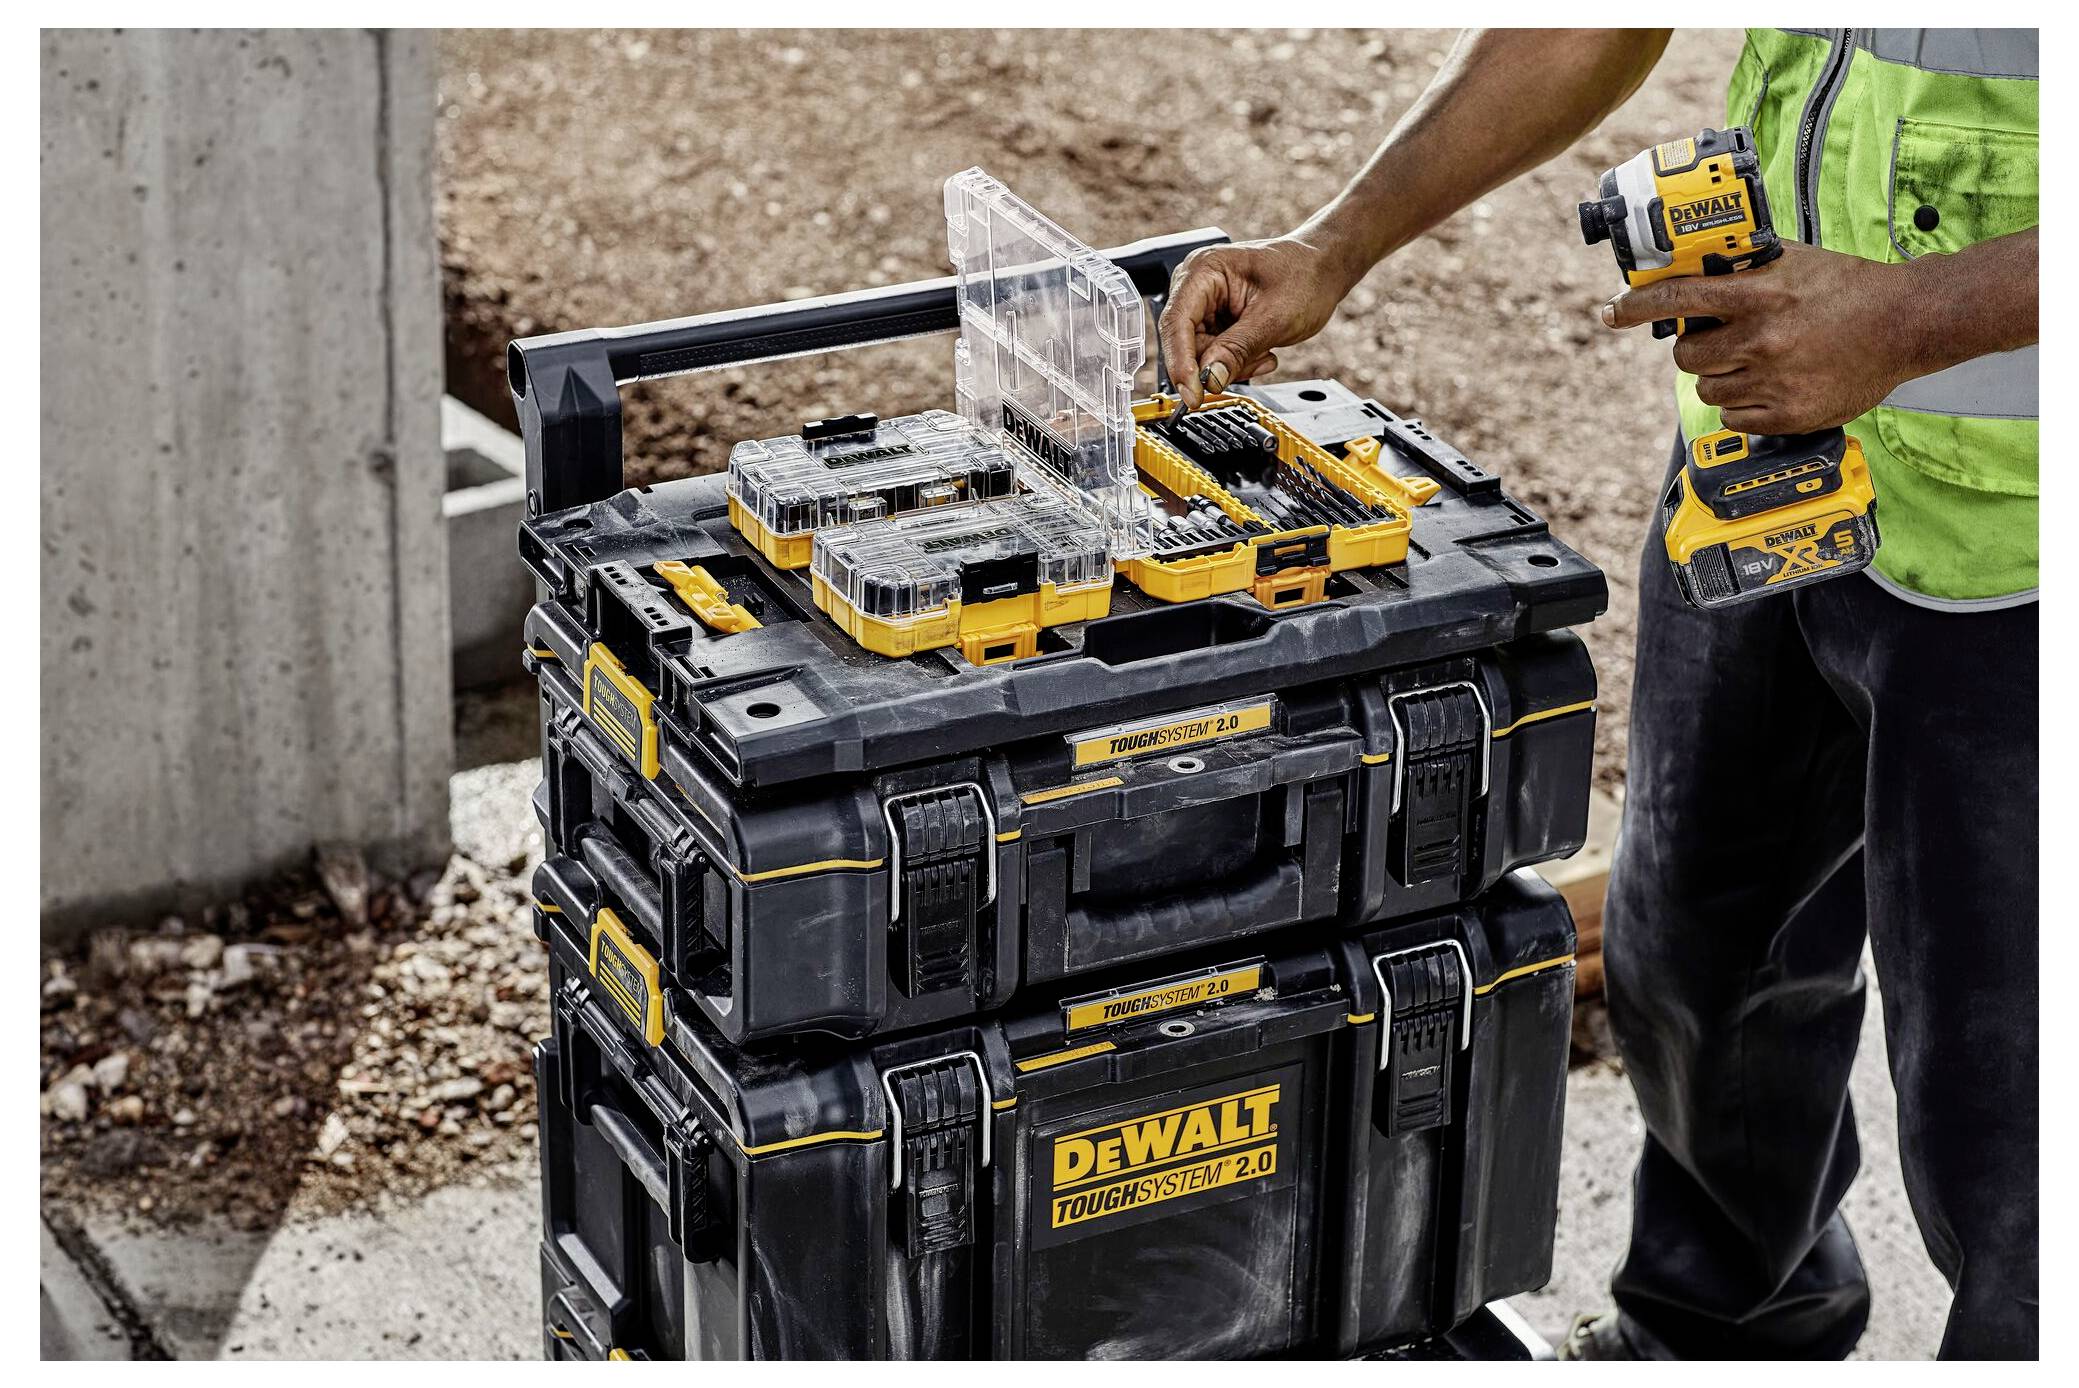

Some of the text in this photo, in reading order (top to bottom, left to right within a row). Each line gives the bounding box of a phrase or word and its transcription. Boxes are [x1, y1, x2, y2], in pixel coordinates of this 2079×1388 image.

[1669, 194, 1742, 222] DEWALT
[1681, 214, 1744, 233] 18V BRUSHLESS
[1764, 525, 1817, 547] DEWALT
[1833, 529, 1855, 549] 5
[1773, 540, 1825, 573] XR
[1742, 558, 1774, 576] 18V
[1783, 566, 1810, 578] LITHIUM
[1216, 715, 1239, 732] 2.0
[1207, 979, 1229, 996] 2.0
[1235, 1151, 1272, 1179] 2.0
